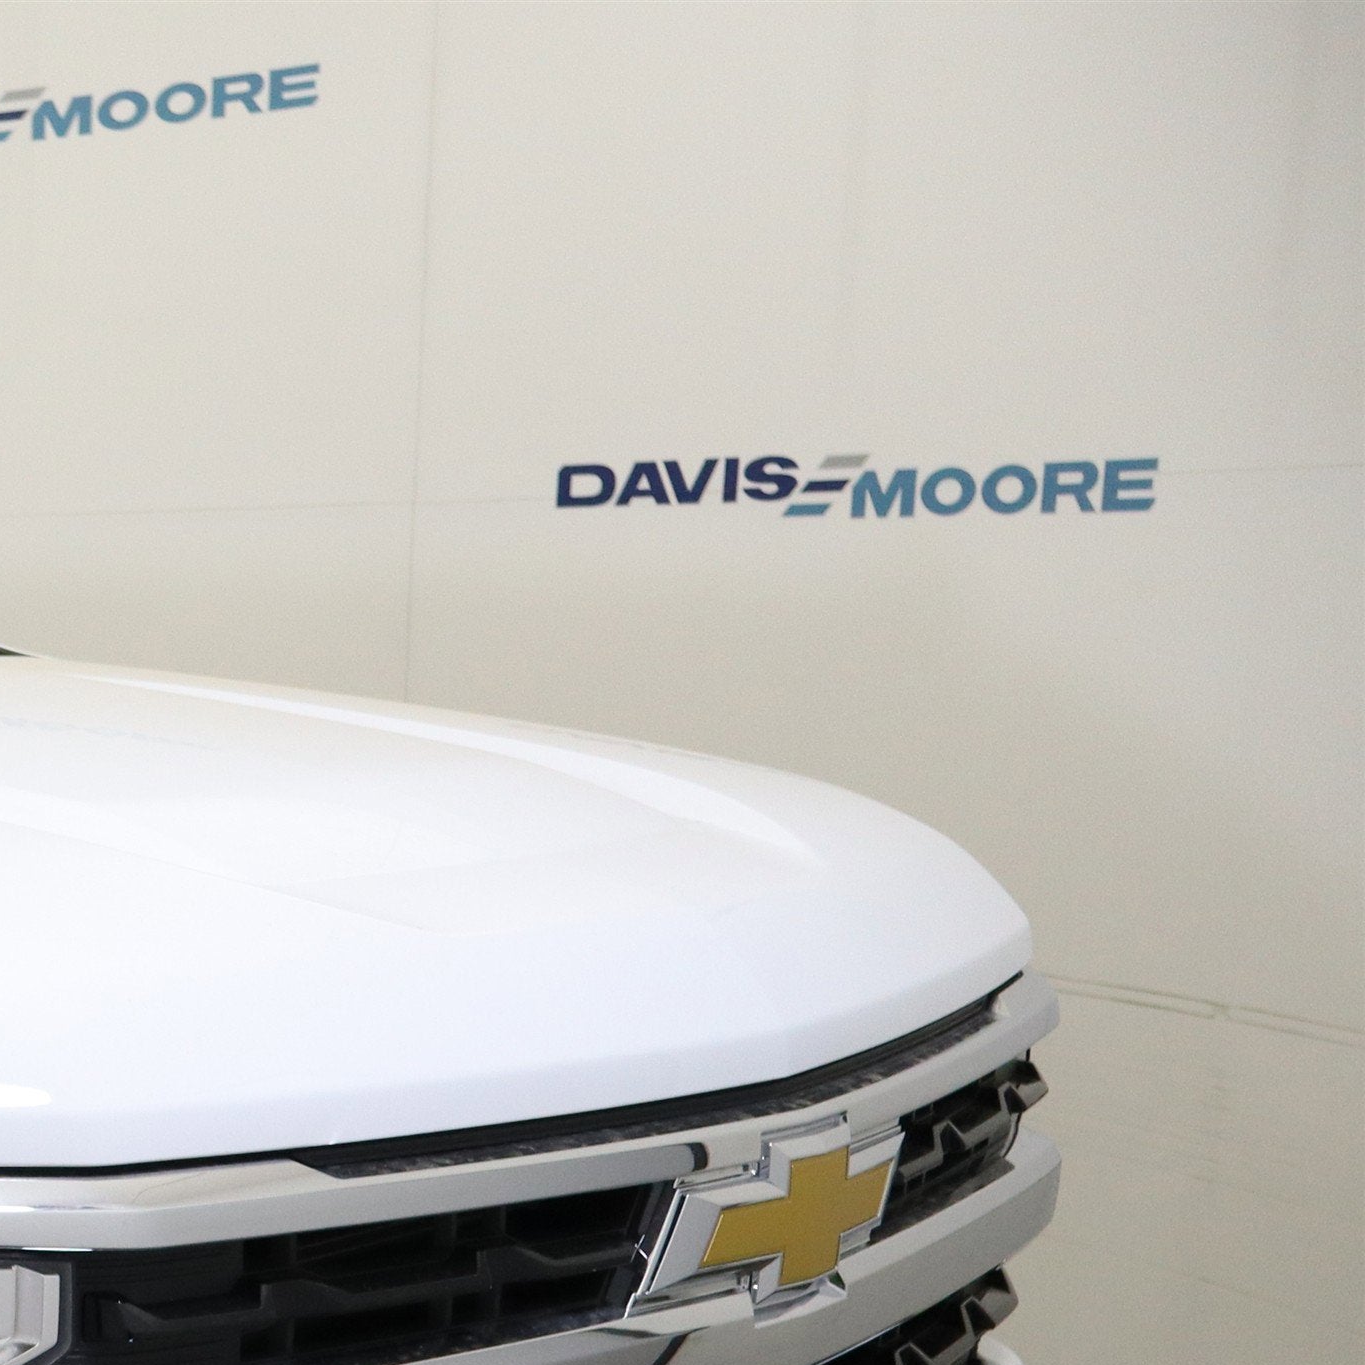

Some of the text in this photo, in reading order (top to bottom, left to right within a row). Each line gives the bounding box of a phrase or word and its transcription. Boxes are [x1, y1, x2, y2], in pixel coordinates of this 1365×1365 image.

[30, 63, 321, 141] MOORE
[555, 454, 1160, 520] DAVIS MOORE
